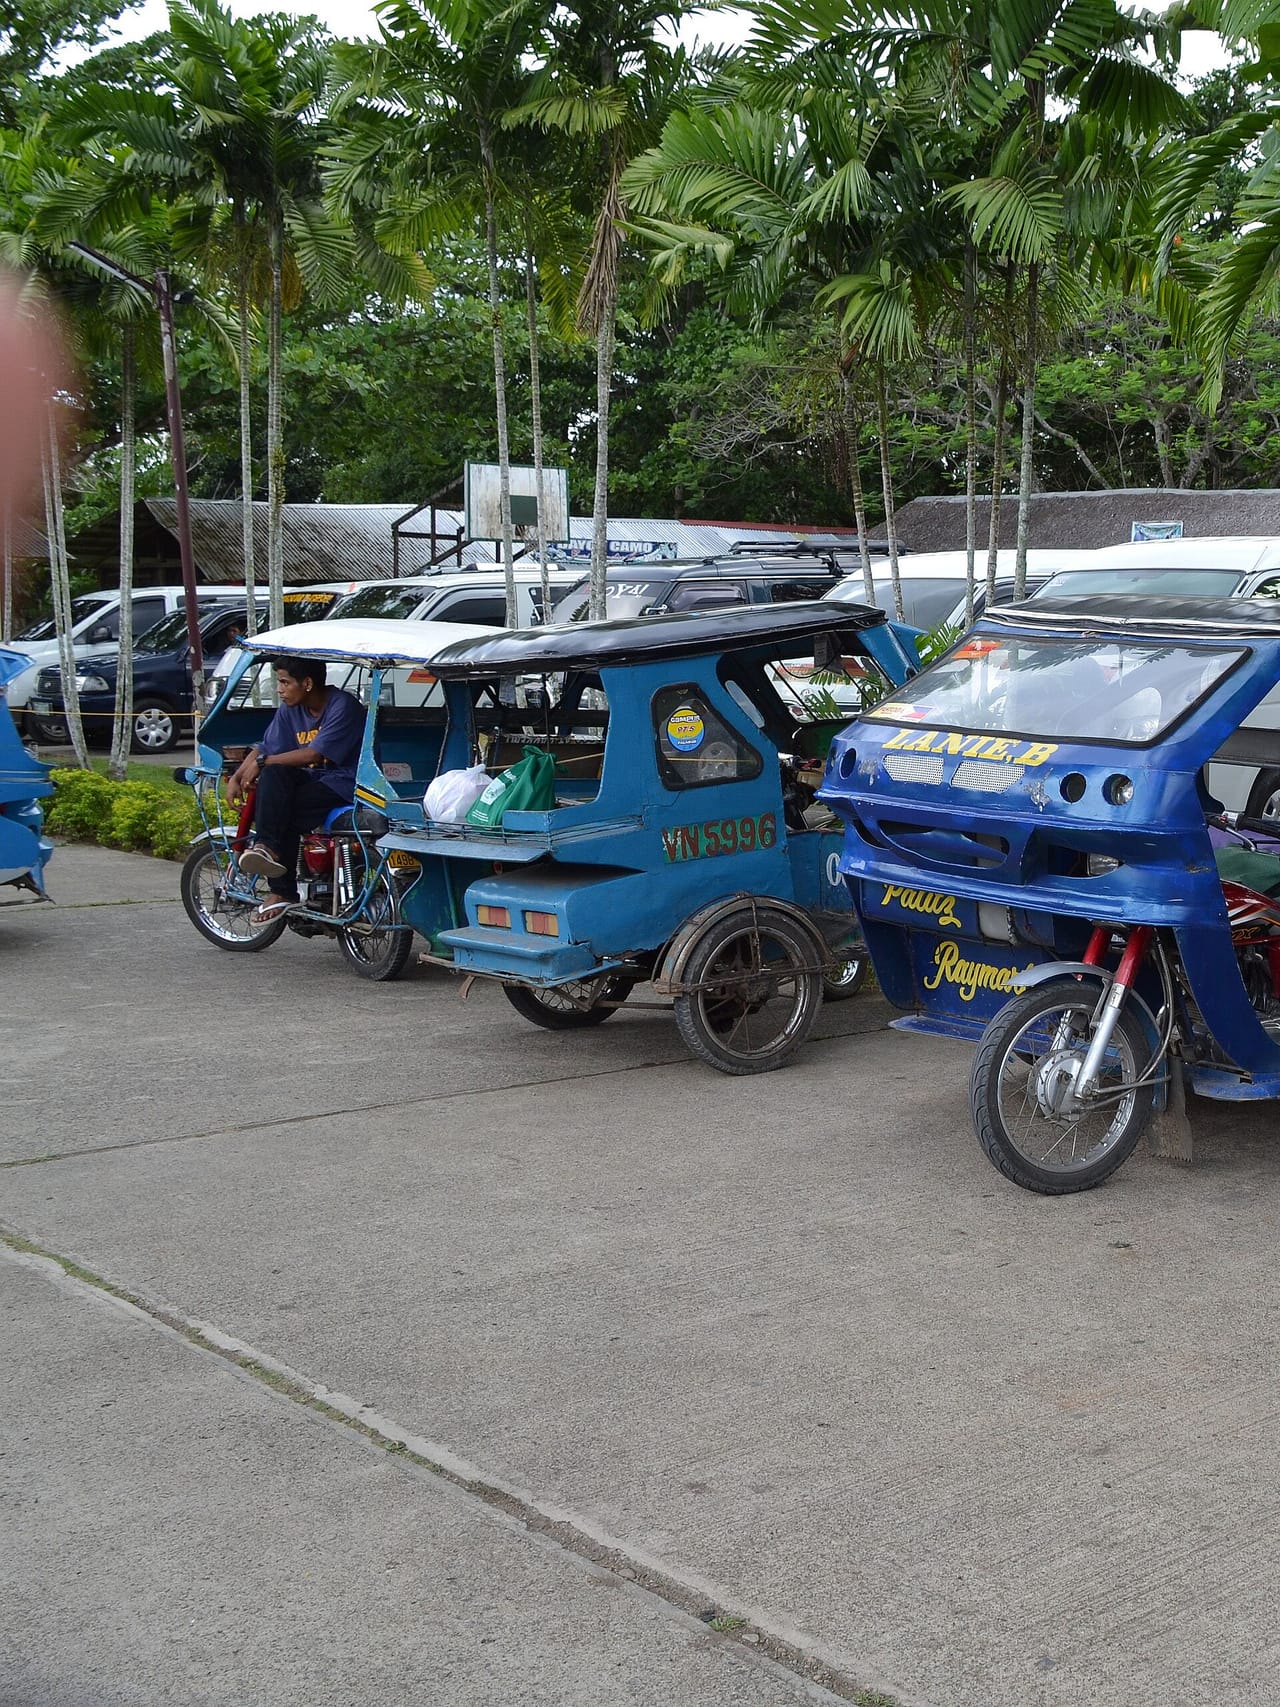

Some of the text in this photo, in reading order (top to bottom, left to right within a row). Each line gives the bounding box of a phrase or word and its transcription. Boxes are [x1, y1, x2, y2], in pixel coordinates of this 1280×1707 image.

[609, 540, 653, 553] CAMO
[662, 813, 776, 862] VN 5996
